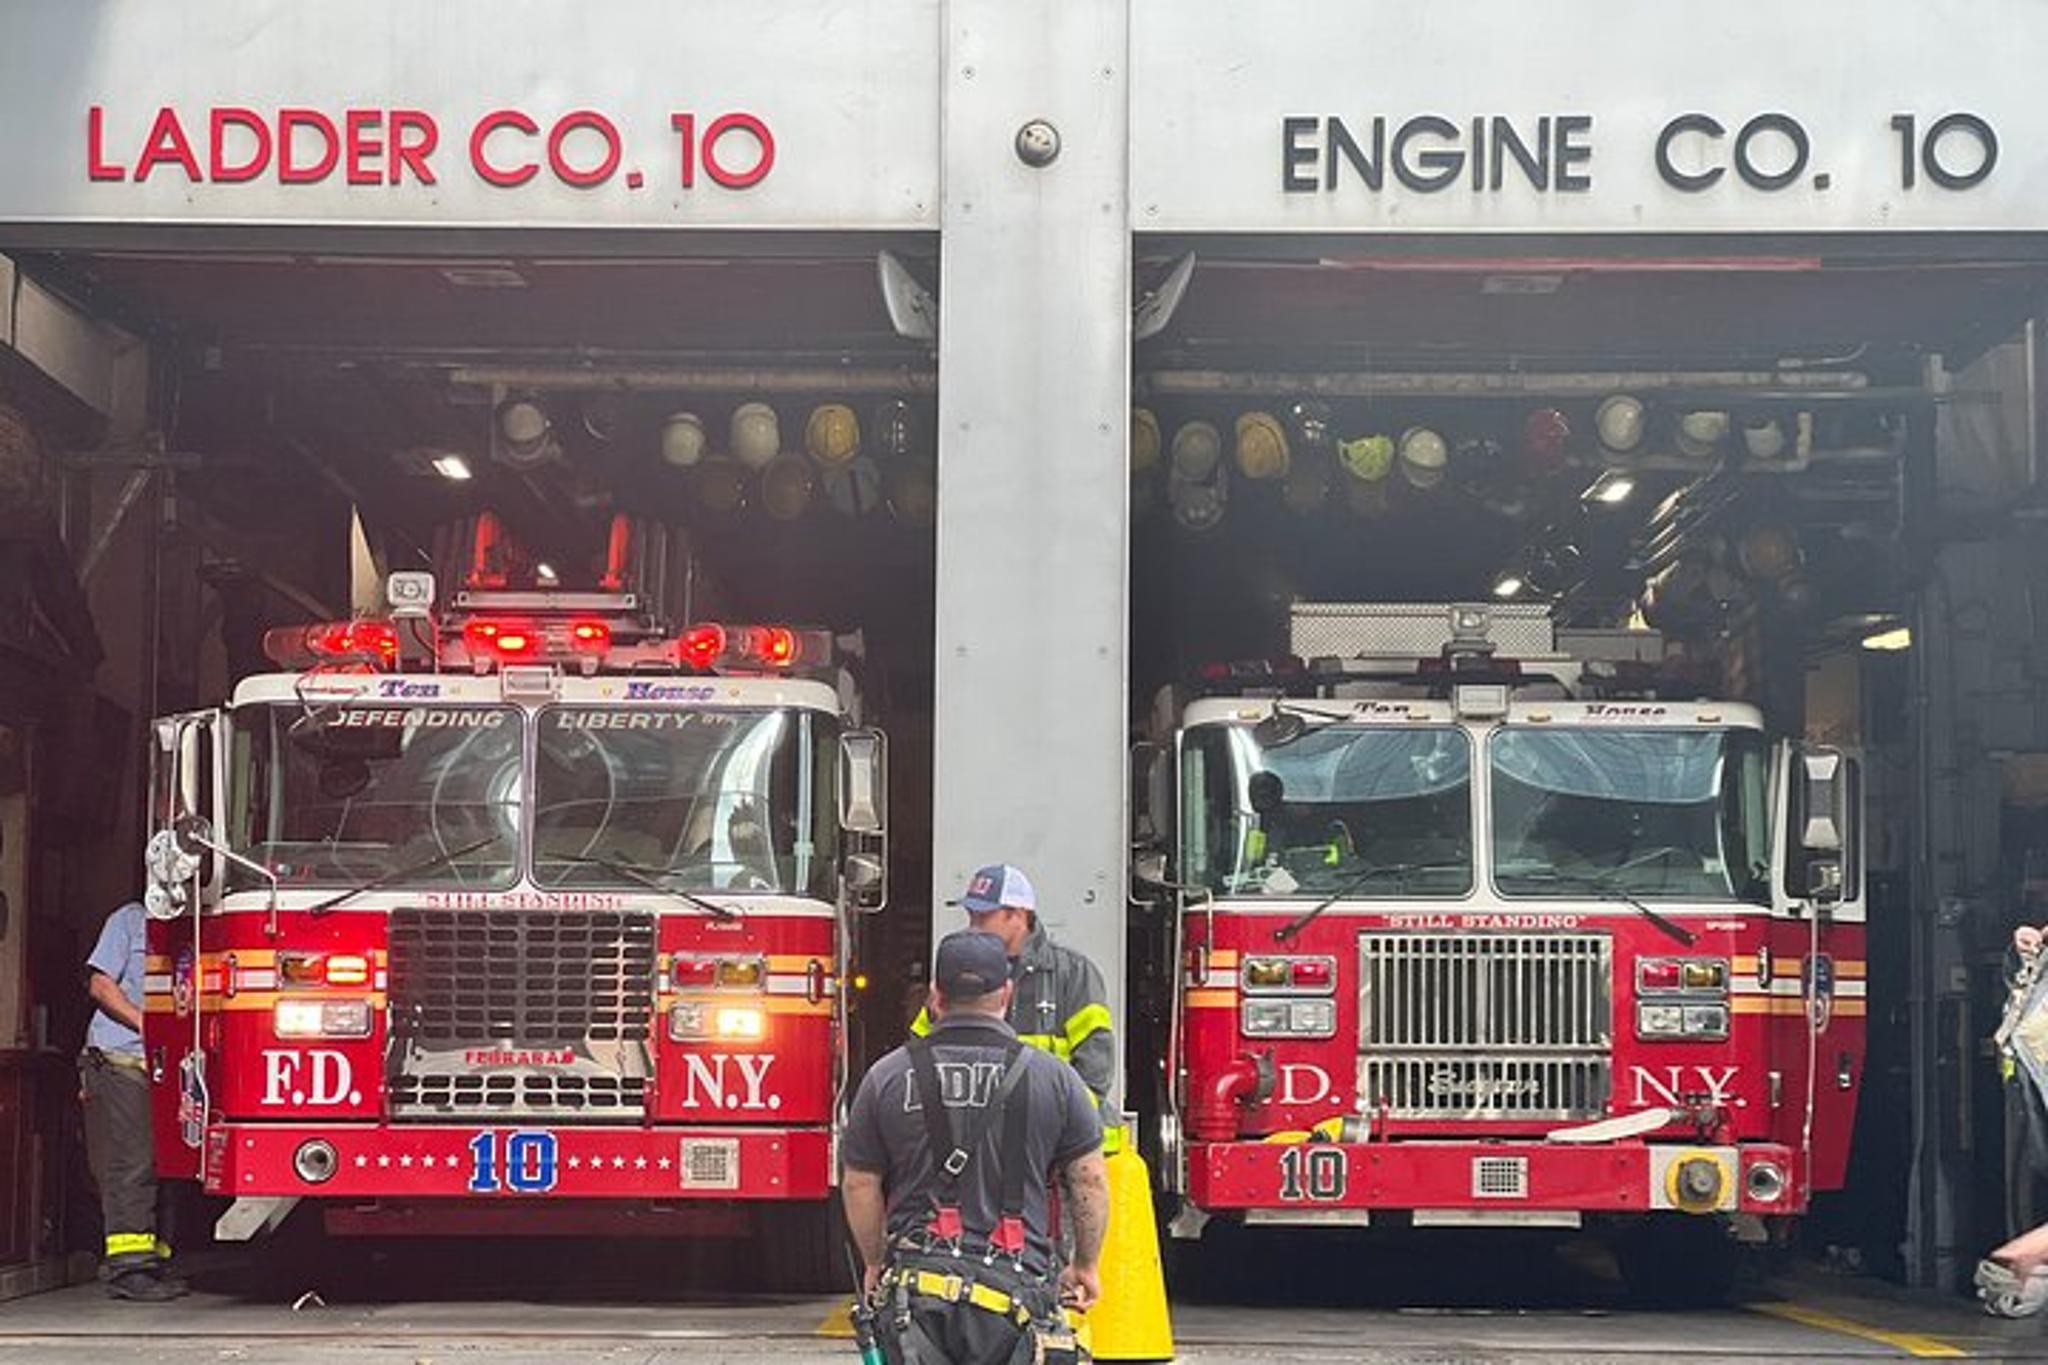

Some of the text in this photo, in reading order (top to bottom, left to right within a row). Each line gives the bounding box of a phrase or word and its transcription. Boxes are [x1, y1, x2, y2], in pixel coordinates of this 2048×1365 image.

[88, 107, 776, 189] LADDER CO. 10
[1282, 113, 2000, 193] ENGINE CO. 10
[378, 679, 441, 698] Ten
[623, 682, 715, 701] House
[557, 712, 694, 730] LIBERTY
[261, 1049, 362, 1106] F.D.
[682, 1053, 781, 1109] N.Y.
[469, 1130, 558, 1193] 10
[1279, 1146, 1346, 1200] 10
